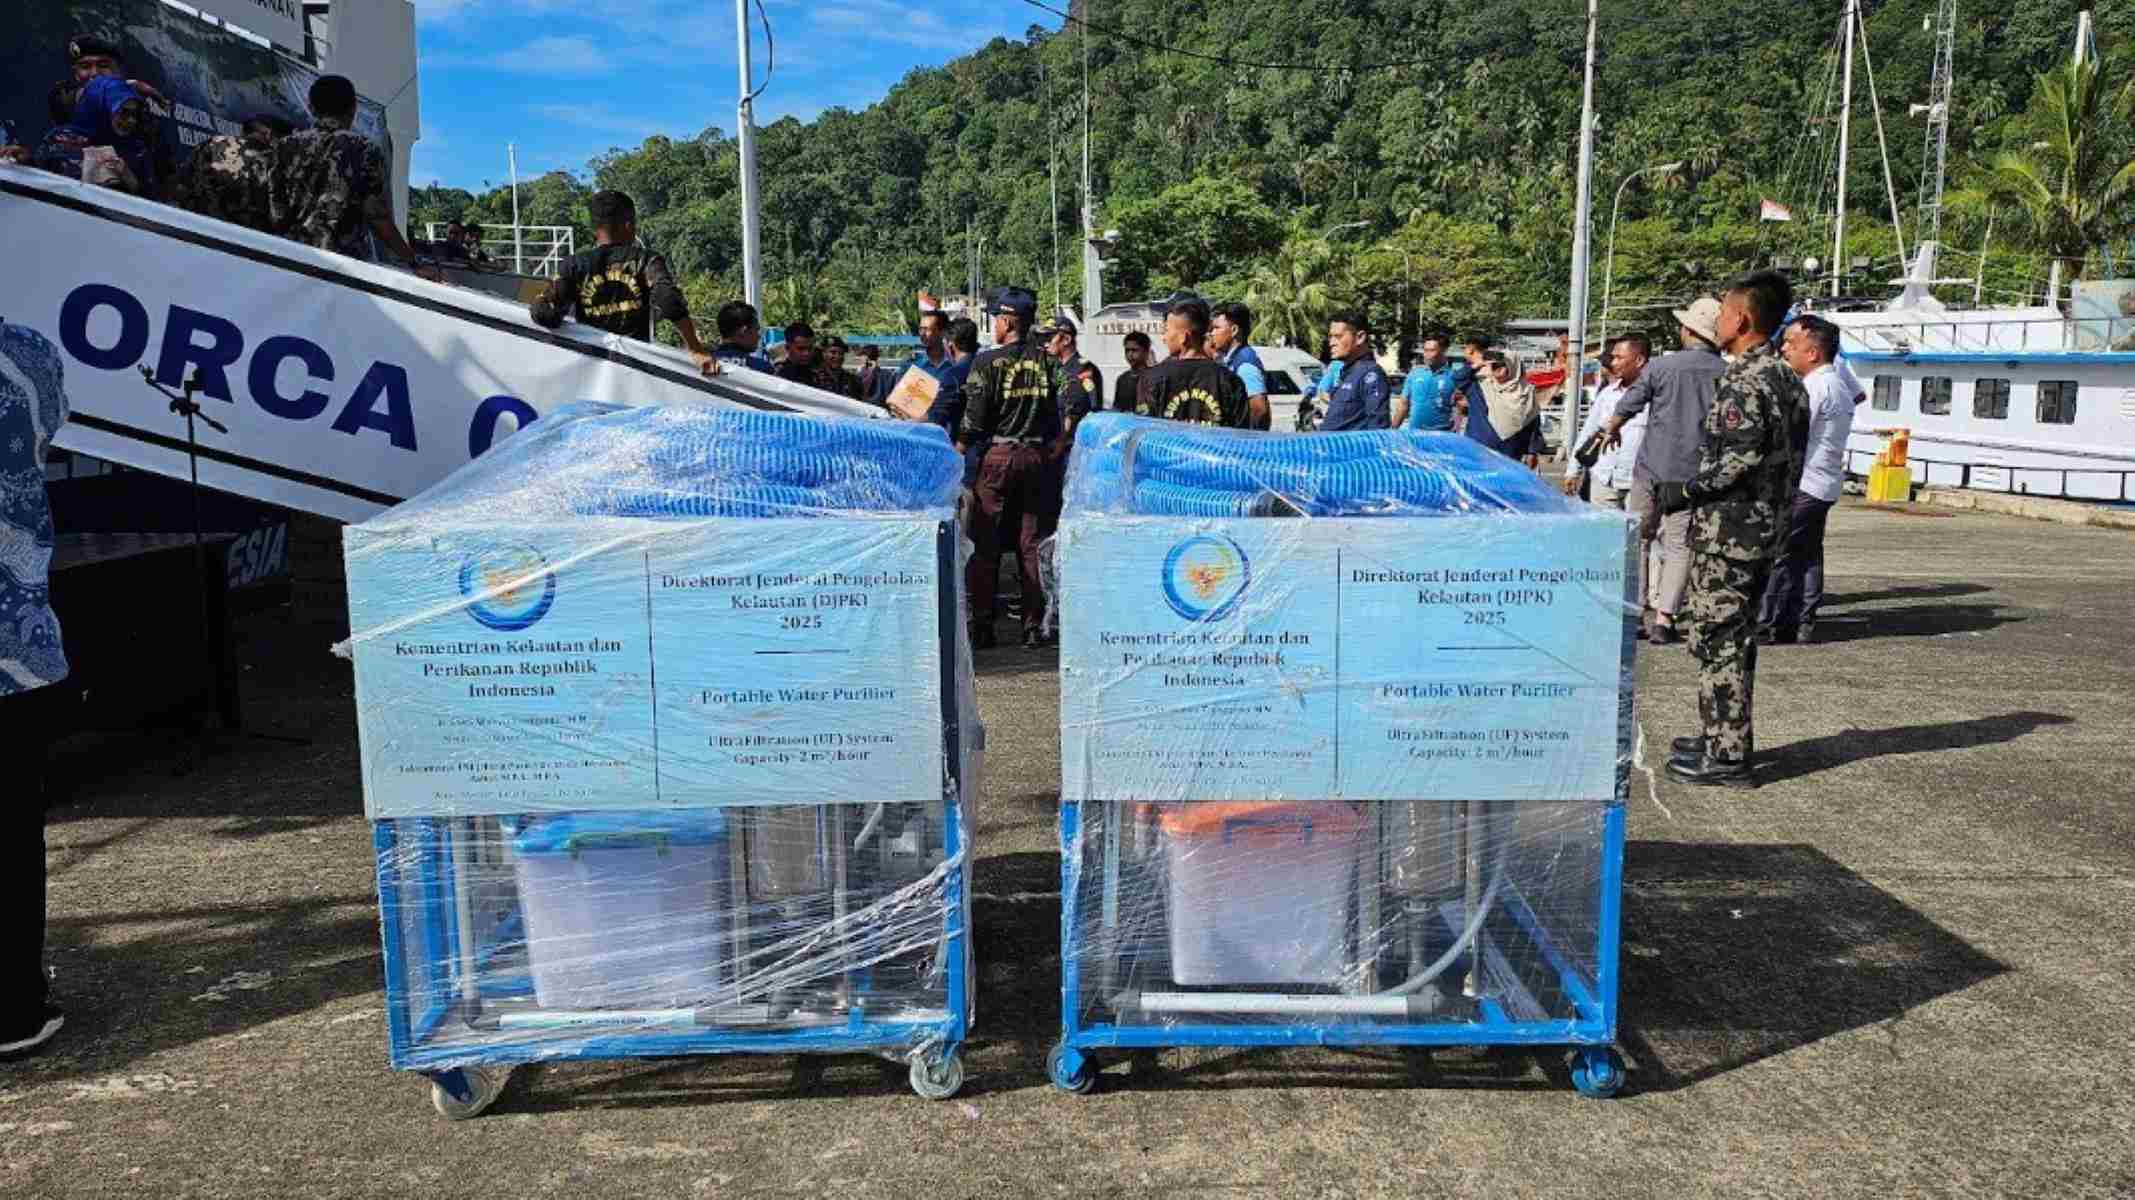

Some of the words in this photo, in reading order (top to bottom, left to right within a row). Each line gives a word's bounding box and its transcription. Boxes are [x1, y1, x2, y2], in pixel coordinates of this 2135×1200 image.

[59, 284, 417, 453] ORCA
[662, 573, 751, 589] Direktorat
[1352, 568, 1438, 583] Direktorat
[1444, 567, 1514, 584] Jenderal
[730, 594, 807, 609] Kelautan
[813, 593, 868, 610] (DJPK)
[1417, 589, 1492, 605] Kelautan
[1497, 589, 1553, 606] (DJPK)
[780, 615, 823, 630] 2025
[1463, 610, 1506, 625] 2025
[1100, 631, 1197, 646] Kementrian
[1279, 630, 1311, 645] dan
[394, 641, 501, 656] Kementrian
[506, 639, 584, 654] Kelautan
[588, 637, 622, 653] dan
[423, 662, 515, 677] Perikanan
[519, 659, 597, 679] Republik
[1163, 672, 1246, 687] Indonesia
[469, 682, 555, 698] Indonesia
[702, 688, 772, 704] Portable
[777, 687, 828, 703] Water
[1383, 682, 1454, 698] Portable
[1457, 683, 1510, 697] Water
[1511, 682, 1577, 697] Purifier
